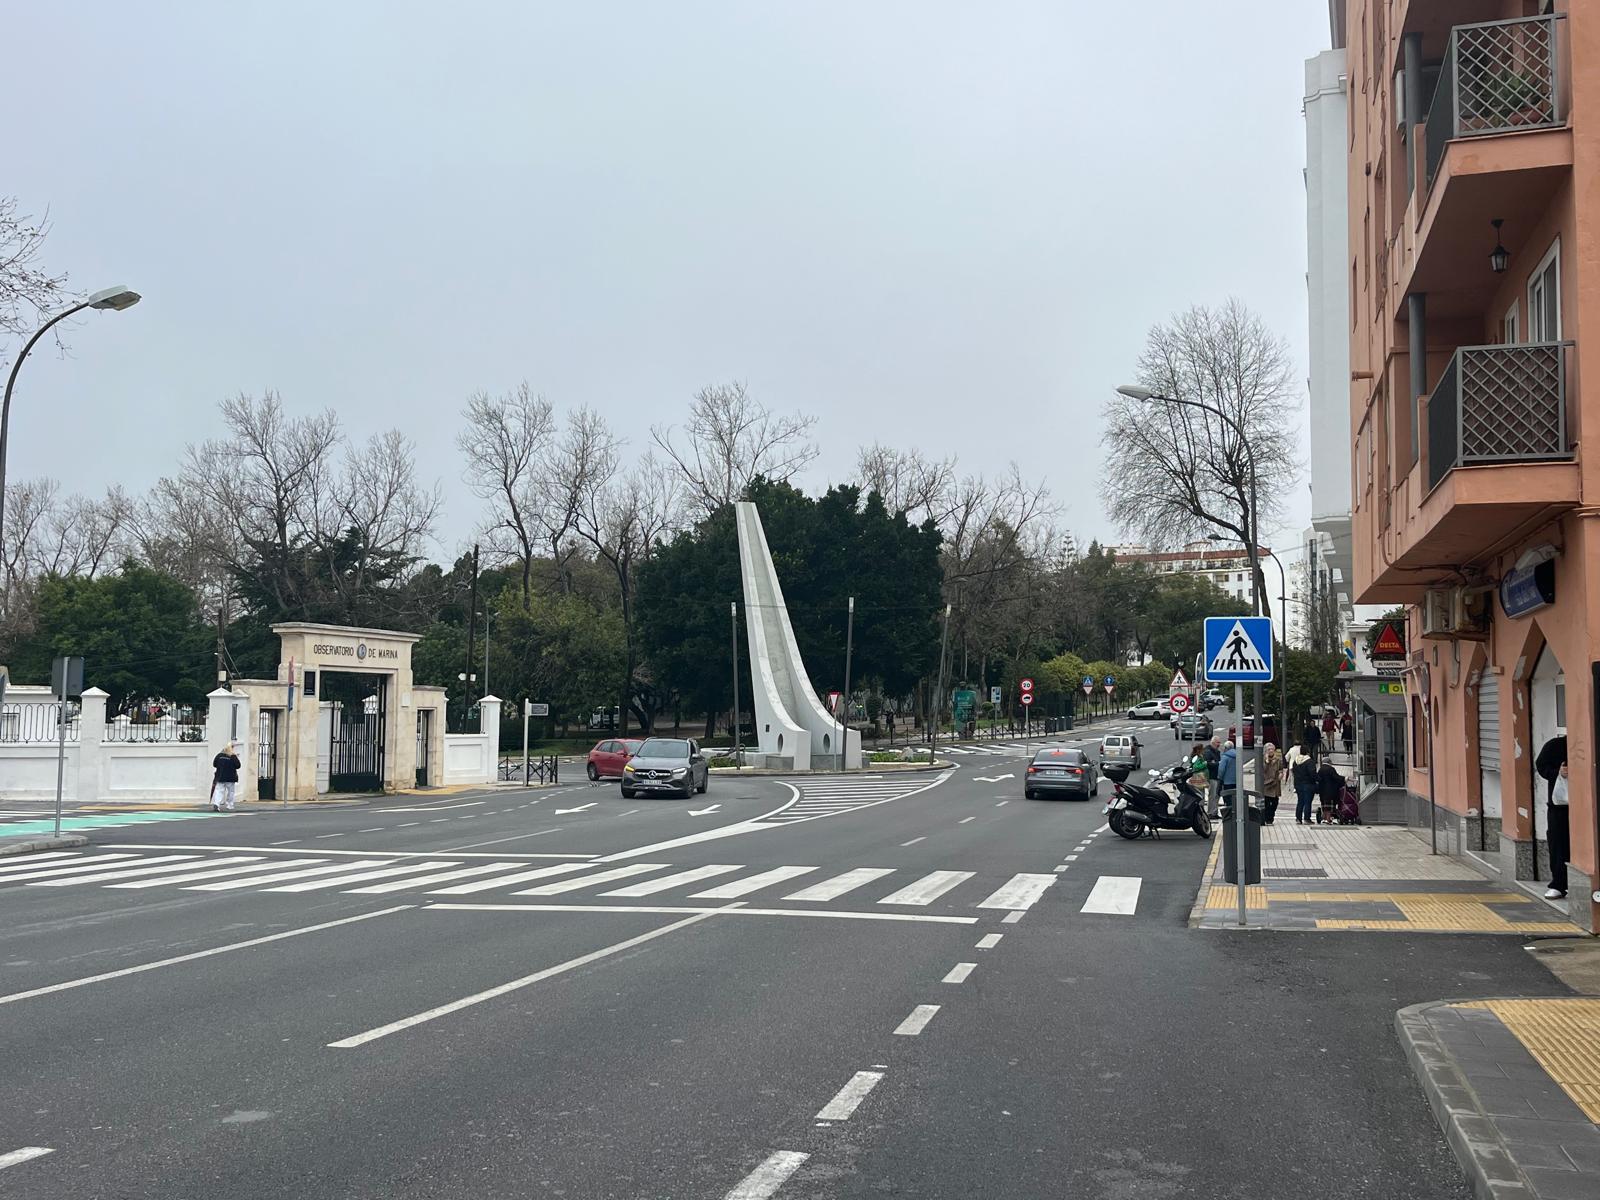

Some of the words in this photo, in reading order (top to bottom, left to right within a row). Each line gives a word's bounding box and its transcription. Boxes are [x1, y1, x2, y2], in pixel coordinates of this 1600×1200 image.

[314, 644, 354, 656] OBSERVATORIO
[368, 648, 376, 658] DE
[378, 649, 398, 659] MARINA
